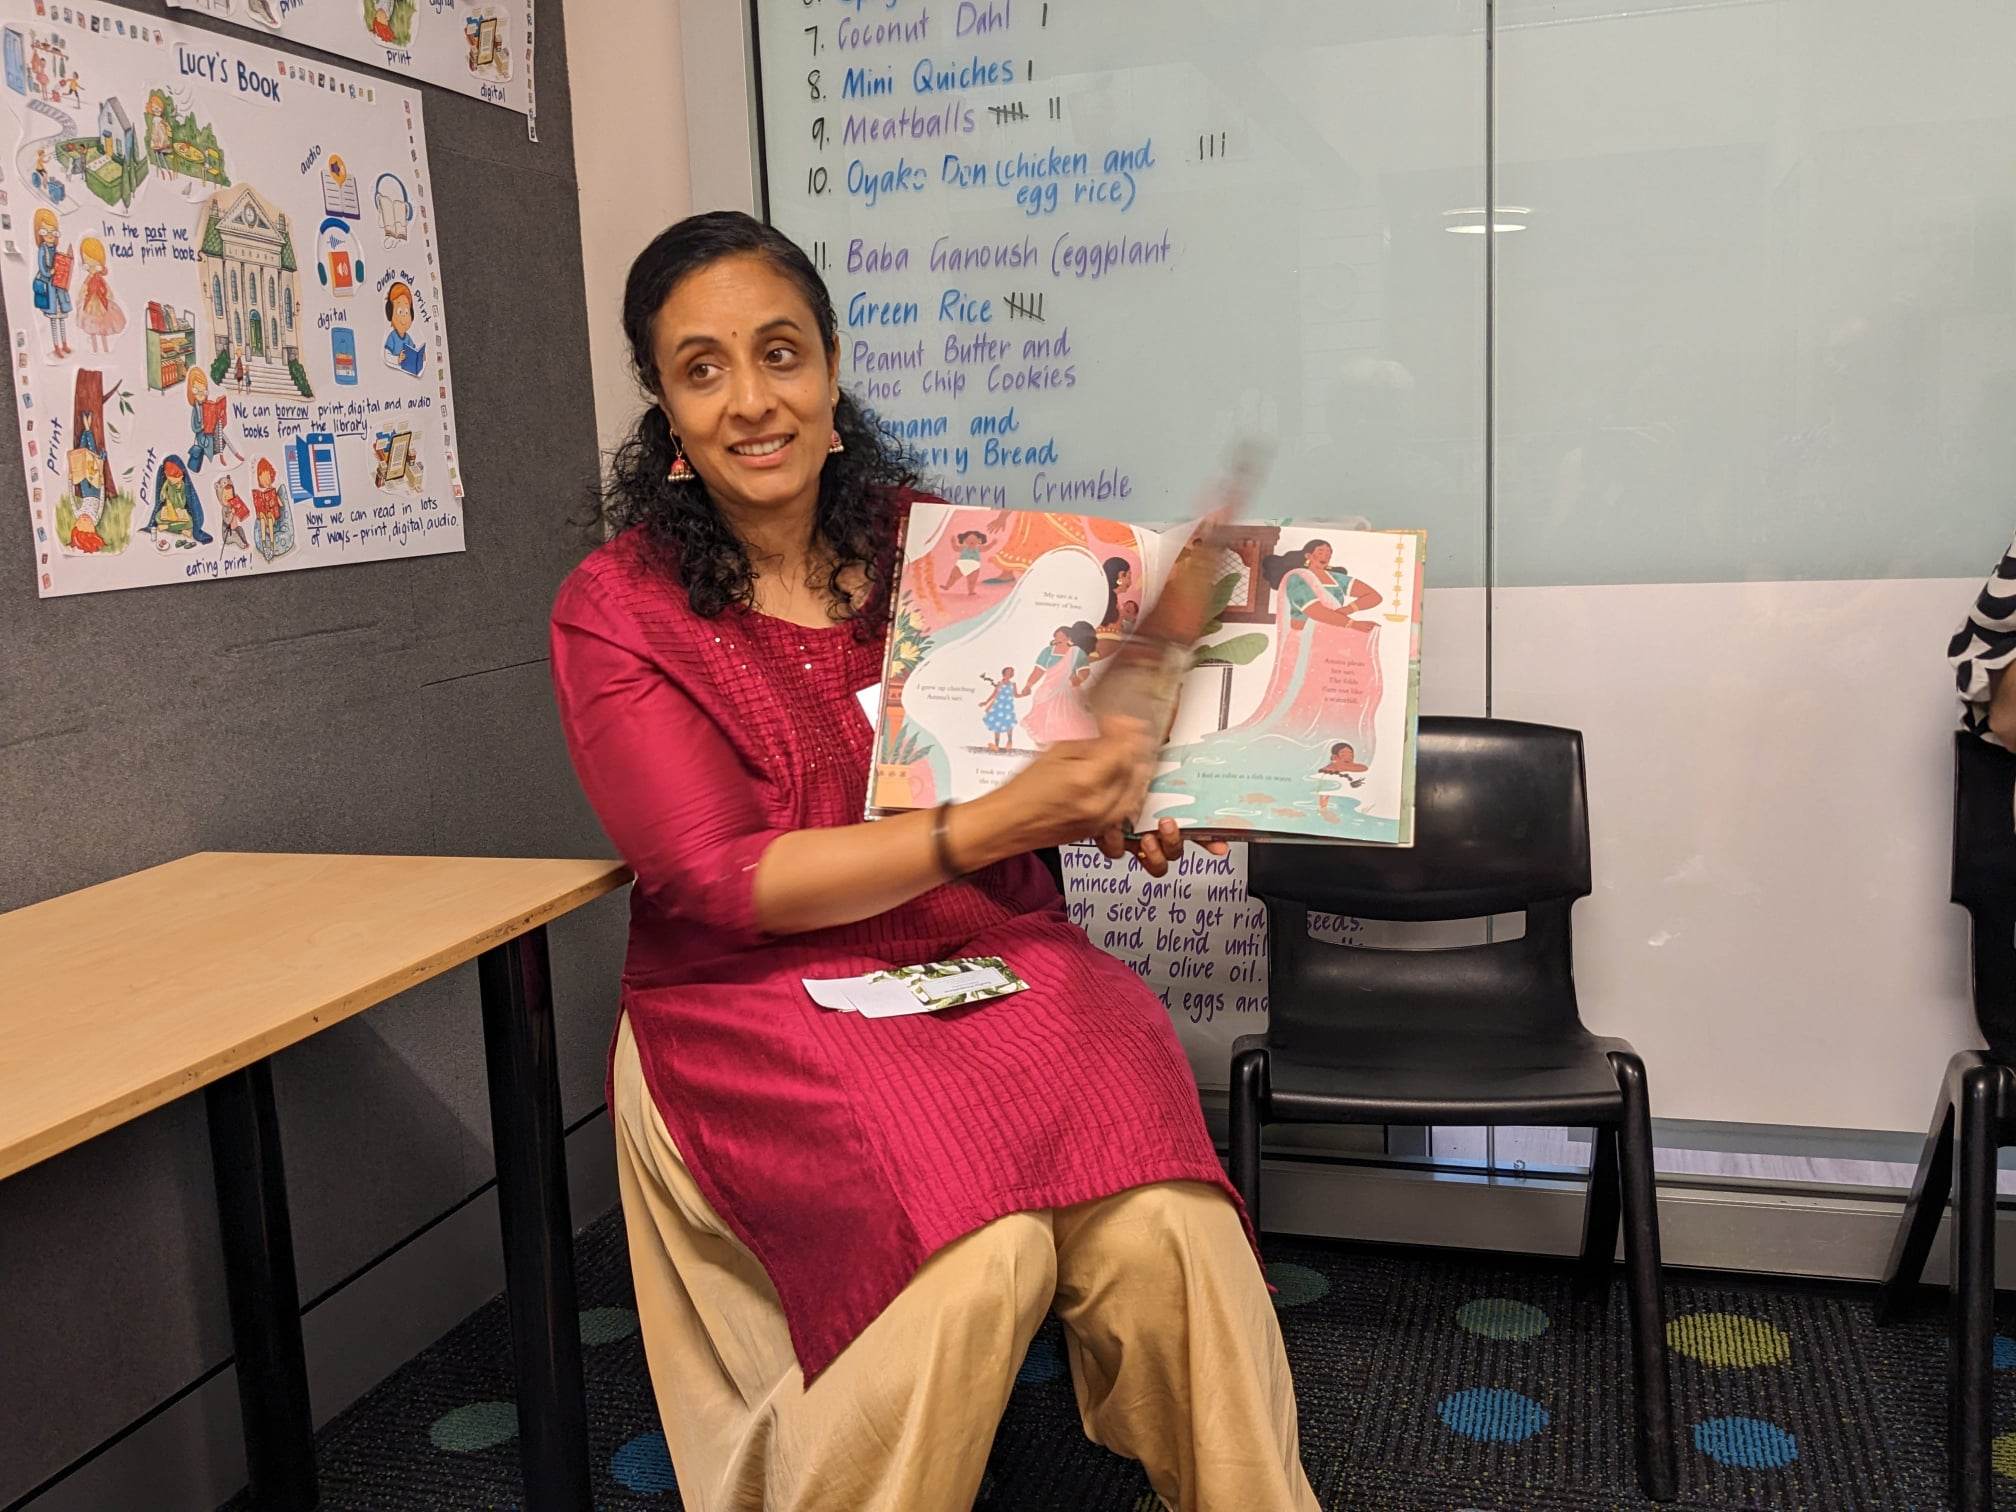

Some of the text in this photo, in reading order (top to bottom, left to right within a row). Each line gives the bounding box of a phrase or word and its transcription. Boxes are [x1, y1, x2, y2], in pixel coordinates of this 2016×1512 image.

[804, 0, 1010, 56] 7. Coconut Dahl
[386, 50, 412, 66] print
[179, 48, 280, 103] LUCY'S BOOK
[808, 56, 1014, 99] 8. Mini Quiches
[480, 82, 506, 103] digital
[812, 101, 976, 150] 9. Meatballs
[300, 144, 322, 175] audio
[808, 166, 832, 195] 10.
[847, 158, 928, 207] Oyako
[995, 145, 1088, 187] (chicken
[1104, 139, 1156, 169] and
[1016, 172, 1137, 215] egg rice)
[102, 220, 188, 243] In the past we
[110, 242, 207, 266] read print books.
[847, 238, 909, 273] Baba
[929, 234, 1038, 272] Ganoush
[376, 268, 432, 323] audio and print
[848, 289, 993, 327] Green Rice
[317, 308, 347, 330] digital
[852, 326, 1071, 373] Peanut Butter and
[922, 369, 967, 400] Chip
[987, 363, 1077, 393] Cookies
[233, 403, 248, 419] We
[253, 404, 271, 417] can
[276, 403, 309, 418] borrow
[347, 401, 381, 422] digital
[385, 398, 402, 411] and
[408, 396, 431, 409] audio
[970, 406, 1021, 437] and
[243, 423, 270, 439] books
[277, 420, 301, 438] from
[311, 420, 327, 433] the
[47, 417, 64, 476] print
[983, 437, 1060, 467] Bread
[139, 446, 156, 505] print
[1032, 466, 1133, 505] Crumble
[306, 497, 438, 526] Now we can read in lots
[311, 528, 321, 547] of
[186, 558, 219, 578] eating
[1063, 847, 1113, 870] atoes
[1177, 849, 1236, 877] blend
[1070, 873, 1249, 907] minced garlic until
[1106, 902, 1157, 922] sieve
[1168, 902, 1187, 924] to
[1192, 906, 1225, 936] get
[1233, 906, 1267, 929] rid
[1103, 926, 1144, 949] and
[1156, 927, 1210, 955] blend
[1225, 933, 1268, 957] until
[1121, 953, 1263, 982] nd olive oil.
[1182, 992, 1226, 1024] eggs
